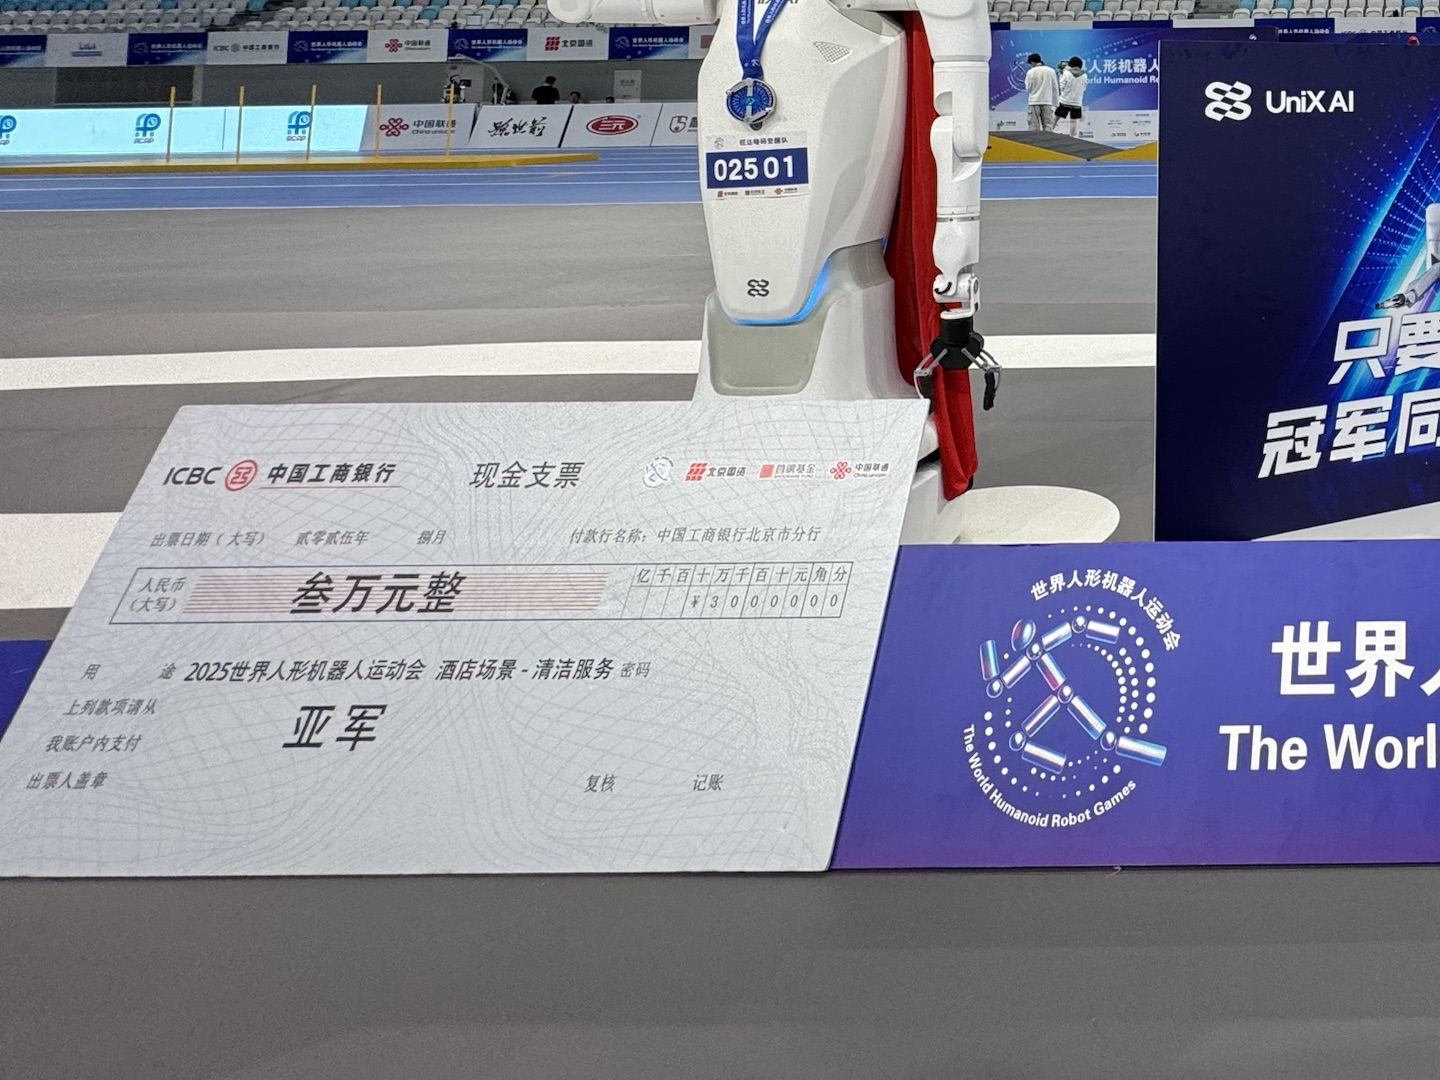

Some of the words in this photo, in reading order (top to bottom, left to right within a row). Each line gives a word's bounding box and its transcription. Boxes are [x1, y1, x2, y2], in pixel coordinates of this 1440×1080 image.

[162, 466, 223, 486] ICBC
[468, 460, 586, 490] 现金支票
[706, 466, 747, 478] 北京国资
[854, 462, 890, 473] 中国联通
[138, 576, 188, 593] 人民币
[289, 570, 468, 615] 叁万元整
[1030, 568, 1181, 652] 世界人形机器人运动会
[183, 659, 427, 683] 2025世界人形机器人运动会
[63, 698, 158, 717] 上列款项请从
[281, 703, 389, 752] 亚军
[963, 723, 976, 754] The
[44, 733, 143, 754] 我账户内支付
[1218, 724, 1308, 771] The
[25, 771, 110, 790] 出票人盖章
[966, 752, 993, 791] World
[583, 773, 618, 794] 复核
[691, 773, 725, 793] 记账
[988, 786, 1049, 828] Humanoid
[1092, 779, 1137, 817] Games
[1050, 808, 1093, 828] Robot
